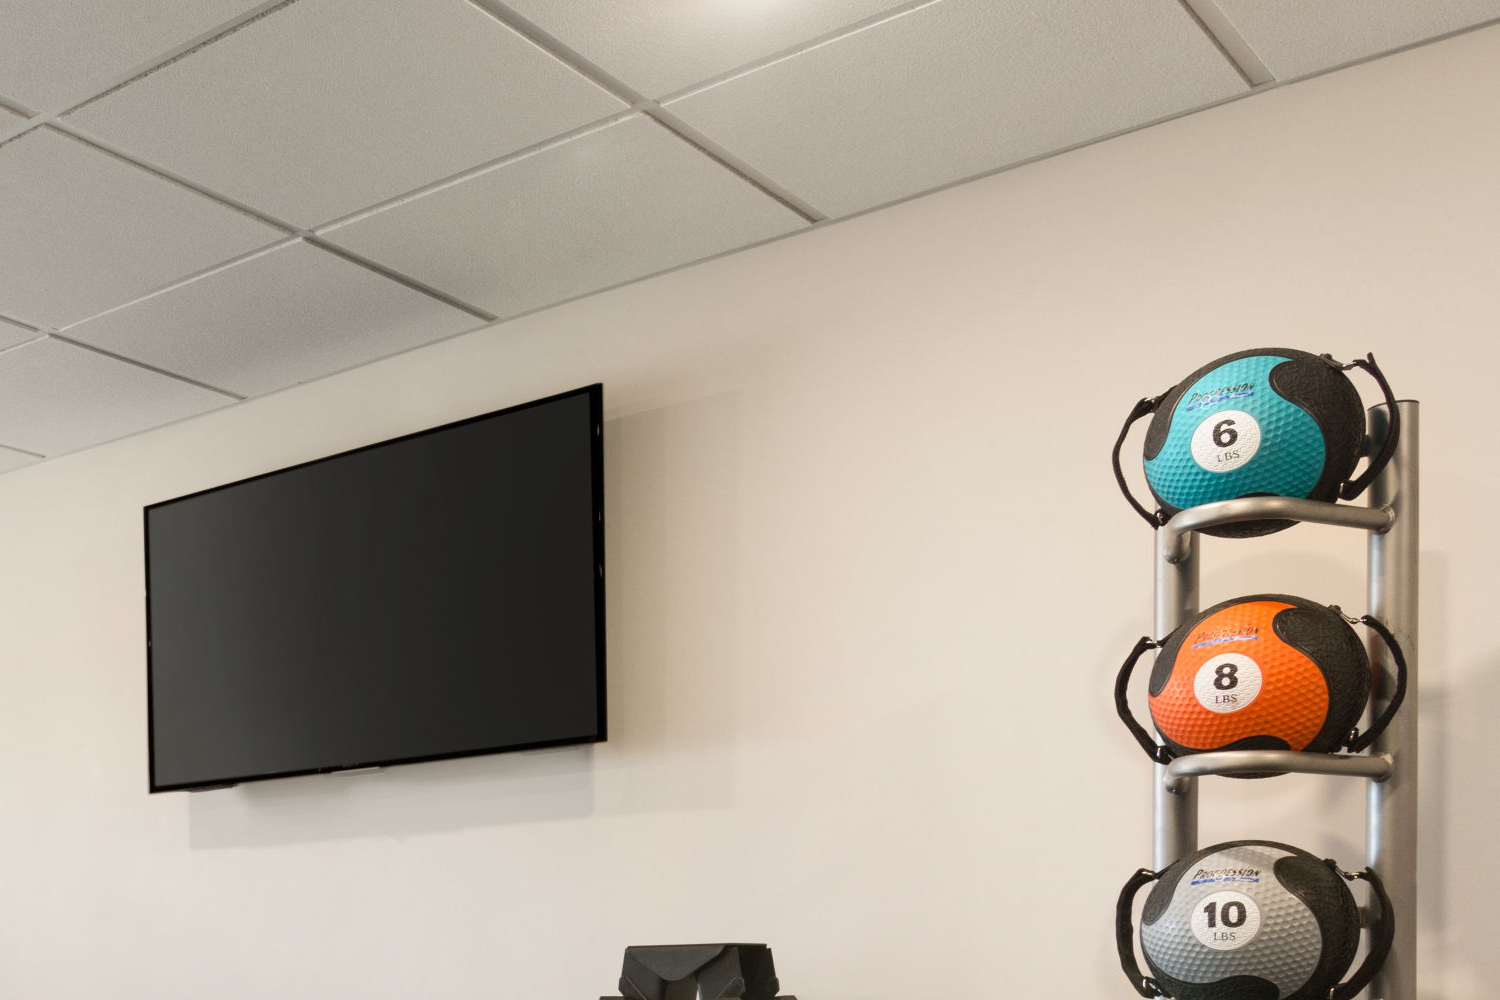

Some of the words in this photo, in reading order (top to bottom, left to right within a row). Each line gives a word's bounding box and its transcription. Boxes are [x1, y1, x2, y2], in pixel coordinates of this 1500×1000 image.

[1213, 419, 1238, 448] 6
[1217, 450, 1240, 462] LBS
[1213, 663, 1239, 690] 8
[1215, 694, 1238, 704] LBS
[1203, 901, 1247, 928] 10
[1213, 932, 1236, 941] LBS
